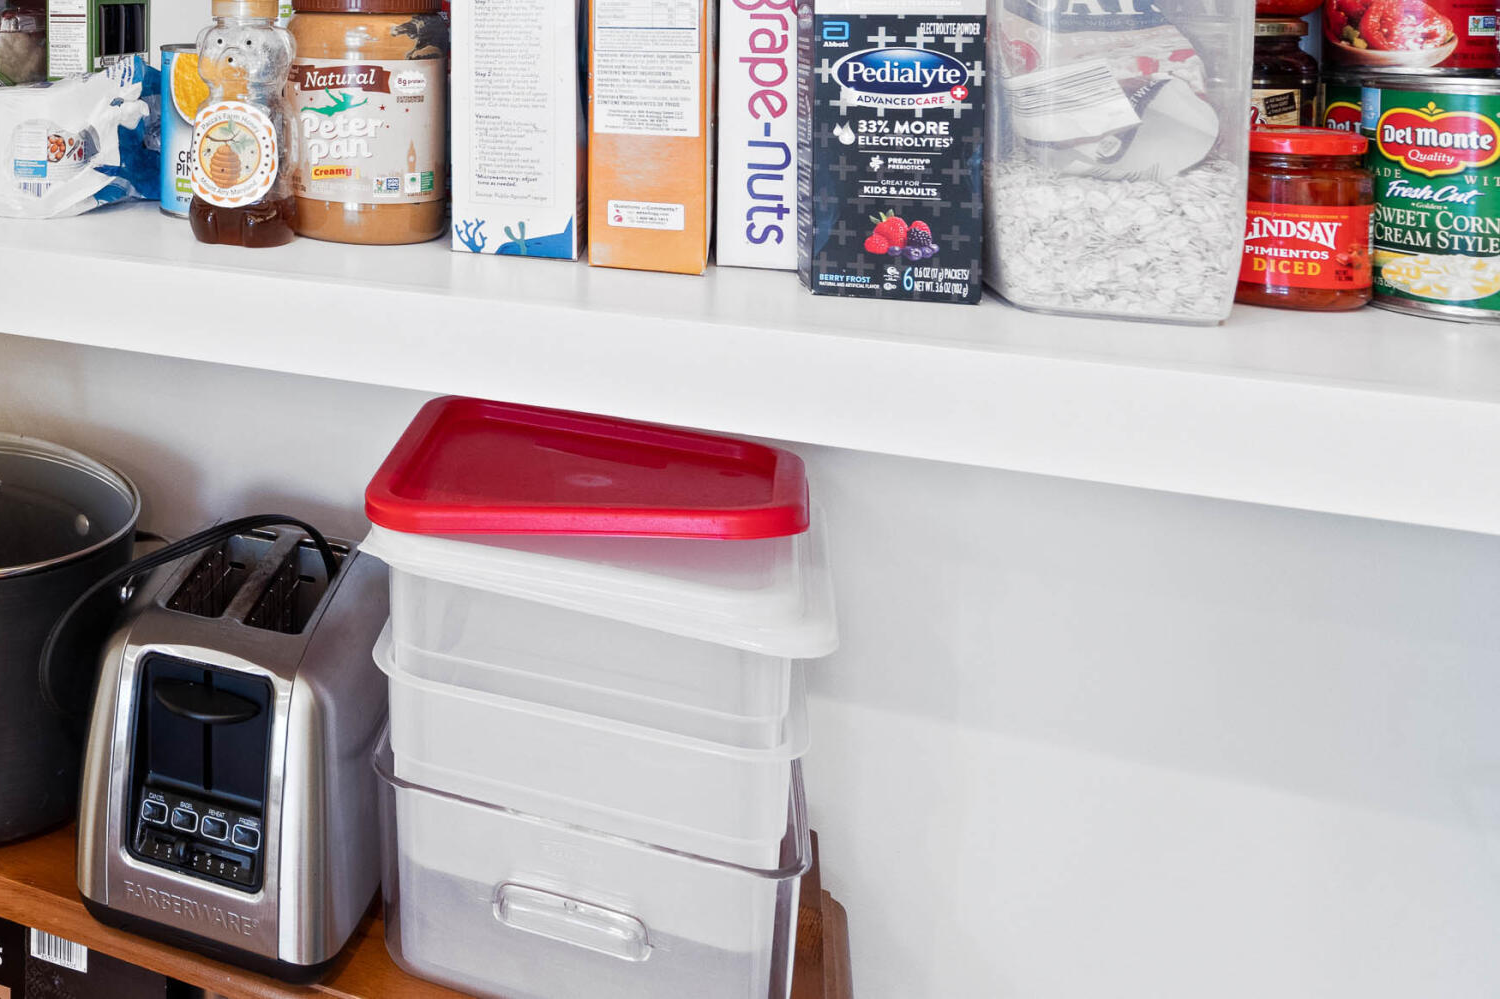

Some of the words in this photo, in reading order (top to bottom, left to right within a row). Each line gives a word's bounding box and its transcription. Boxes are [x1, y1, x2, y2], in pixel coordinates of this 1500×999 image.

[920, 23, 956, 35] ELECTROLYTE
[956, 23, 981, 35] POWDER
[304, 69, 376, 88] Natural
[397, 77, 407, 86] 8g
[846, 61, 961, 88] Pedialyte
[300, 112, 384, 140] Peter
[858, 120, 890, 133] 33%
[894, 120, 949, 135] MORE
[1383, 125, 1413, 144] Del
[1415, 127, 1494, 151] Monte
[1408, 149, 1455, 166] Quality
[313, 166, 353, 178] Creamy
[1464, 175, 1500, 187] WIT
[864, 185, 888, 194] KIDS
[889, 186, 897, 195] &
[899, 186, 938, 196] ADULTS
[1386, 179, 1429, 200] Fresh
[1432, 184, 1484, 205] Cut
[1415, 201, 1442, 210] Golden
[1374, 203, 1431, 229] SWEET
[1435, 209, 1500, 235] CORN
[1374, 223, 1432, 248] CREAM
[1437, 230, 1500, 253] STYLE
[1245, 245, 1329, 260] PIMIENTOS
[1252, 258, 1322, 276] DICED
[819, 273, 844, 282] BERRY
[845, 275, 871, 283] FROST
[903, 267, 913, 291] 6
[914, 281, 924, 291] NET
[944, 284, 952, 294] OZ
[180, 801, 193, 810] BAGEL
[208, 808, 226, 818] REHEAT
